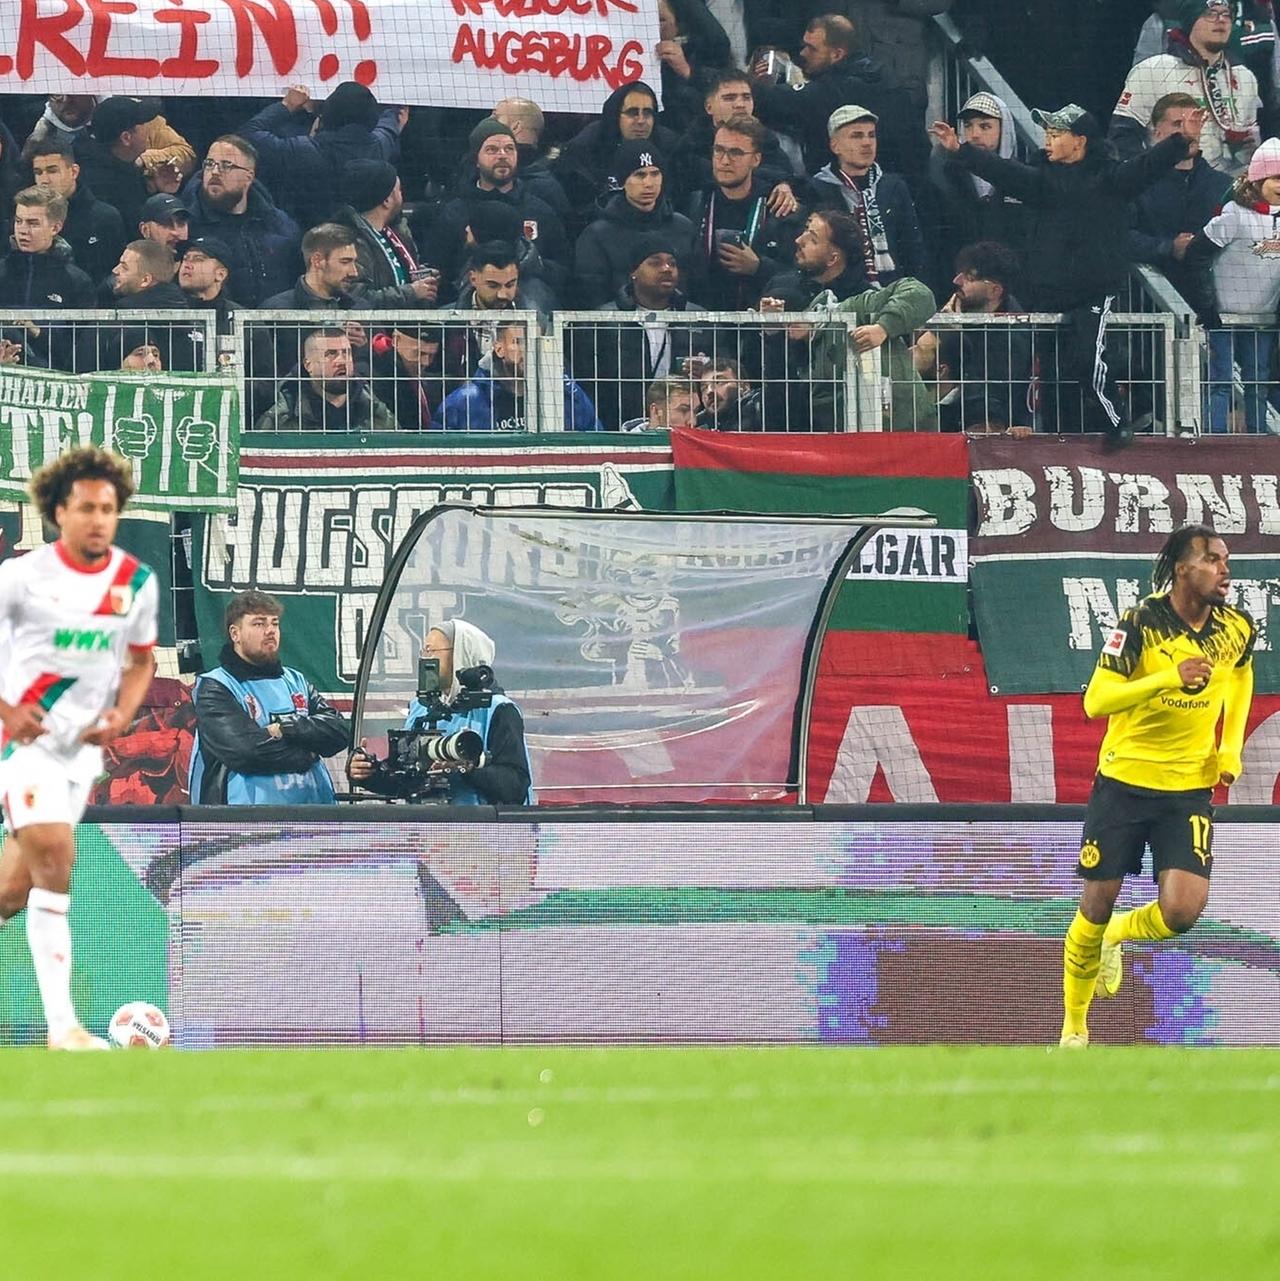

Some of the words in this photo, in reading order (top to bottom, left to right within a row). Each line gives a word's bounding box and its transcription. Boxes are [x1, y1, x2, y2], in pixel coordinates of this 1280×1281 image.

[451, 25, 644, 90] AUGSBURG
[52, 627, 116, 650] WWK
[1161, 696, 1211, 710] vodafone
[1188, 814, 1211, 851] 17
